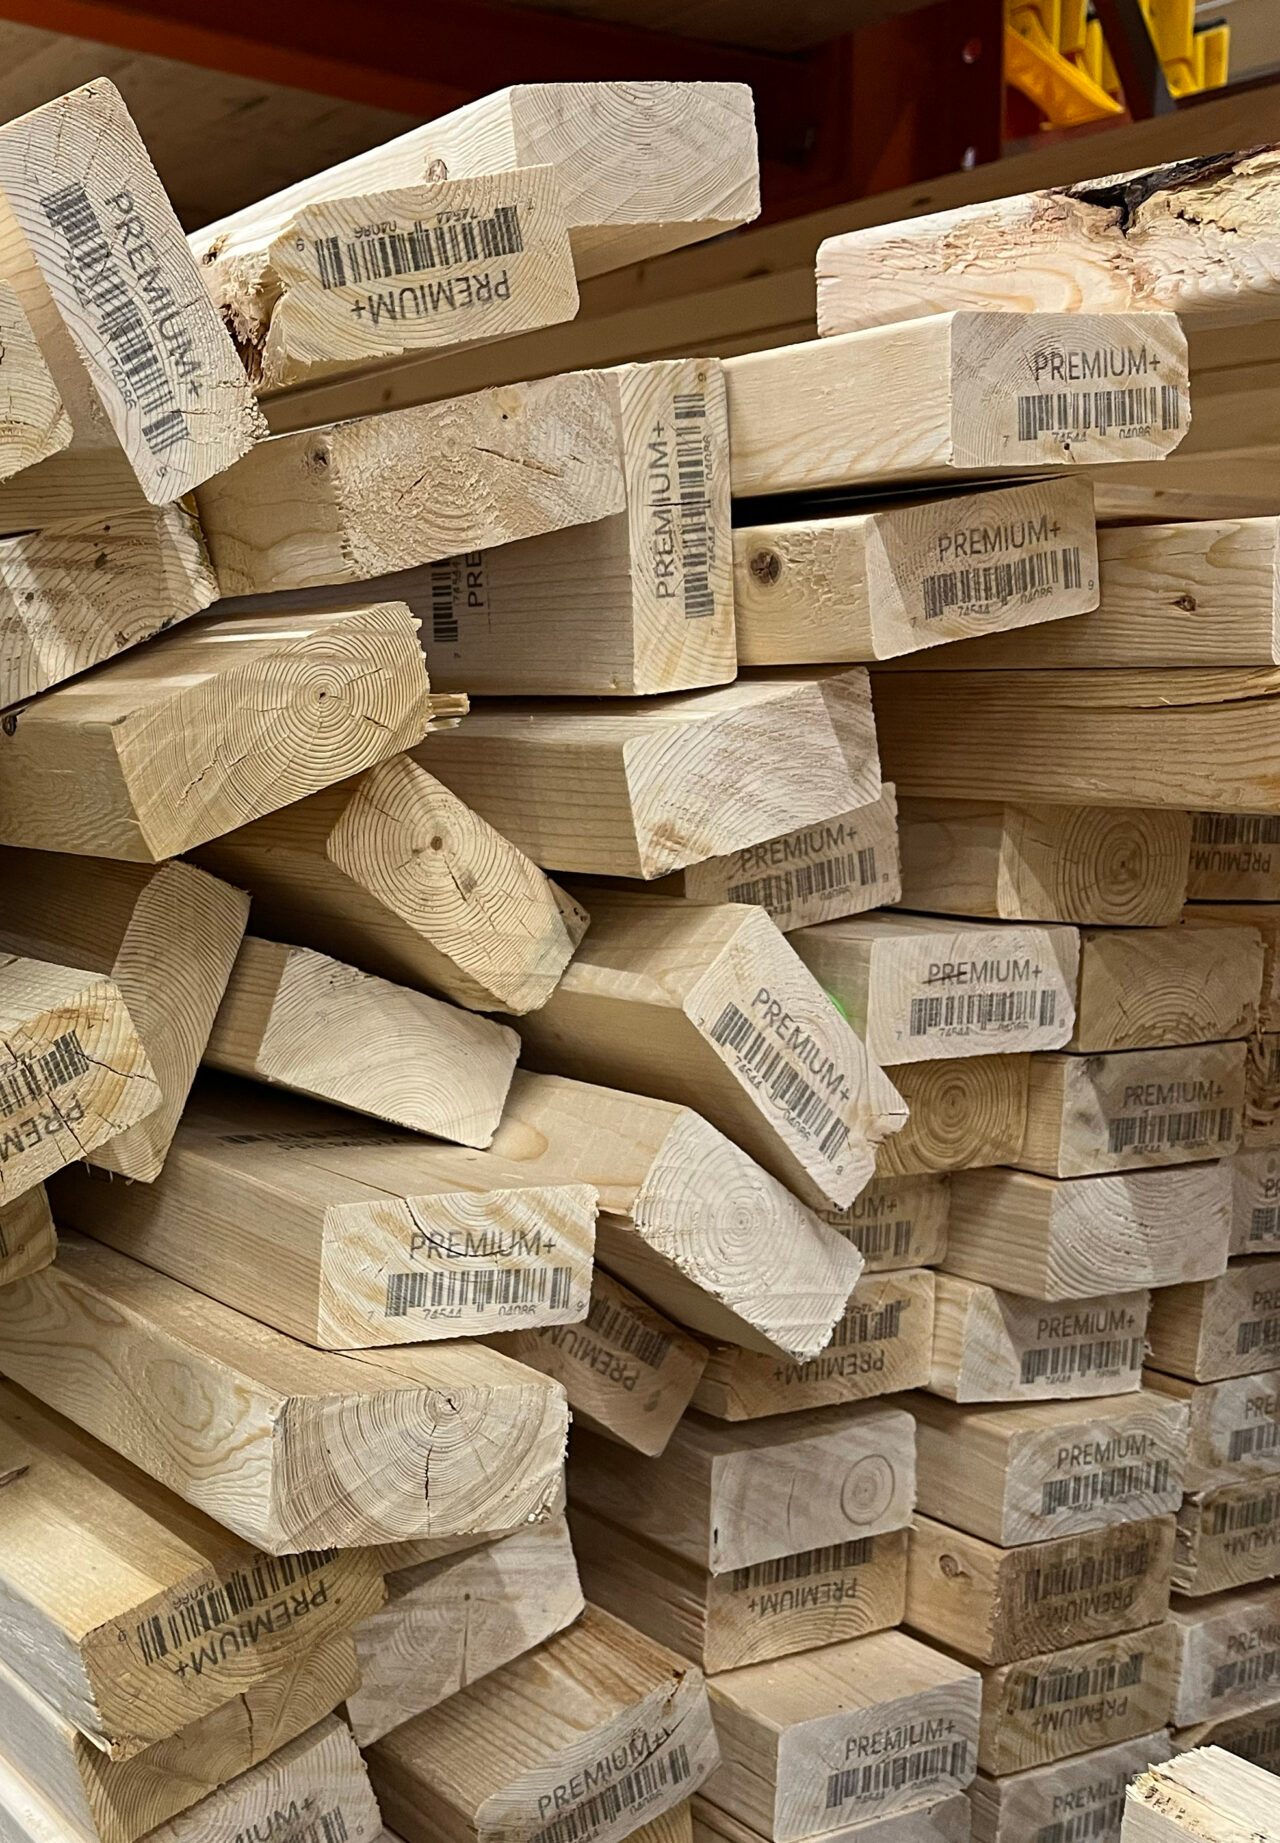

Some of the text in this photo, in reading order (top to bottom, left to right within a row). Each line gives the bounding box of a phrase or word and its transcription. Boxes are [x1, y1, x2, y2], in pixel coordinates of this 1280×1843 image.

[105, 188, 204, 400] PREMIUM+
[350, 269, 512, 326] PREMIUM+
[1034, 344, 1161, 382] PREMIUM+
[646, 420, 677, 600] PREMIUM+
[937, 514, 1062, 562] PREMIUM+
[956, 603, 991, 618] 74544
[740, 823, 858, 873] PREMIUM+
[927, 958, 1044, 987] PREMIUM+
[750, 986, 851, 1102] PREMIUM+
[734, 1054, 764, 1091] 74544
[1124, 1079, 1225, 1109] PREMIUM+
[409, 1230, 557, 1261] PREMIUM+
[422, 1308, 463, 1320] 74544
[1036, 1309, 1136, 1341] PREMIUM+
[538, 1325, 641, 1392] PREMIUM
[773, 1350, 886, 1385] PREMIUM+
[1056, 1434, 1158, 1470] PREMIUM+
[747, 1577, 858, 1617] PREMIUM+
[173, 1580, 329, 1677] PREMIUM+
[1032, 1696, 1128, 1734] PREMIUM+
[845, 1717, 957, 1761] PREMIUM+
[537, 1727, 665, 1821] PREMIUM+
